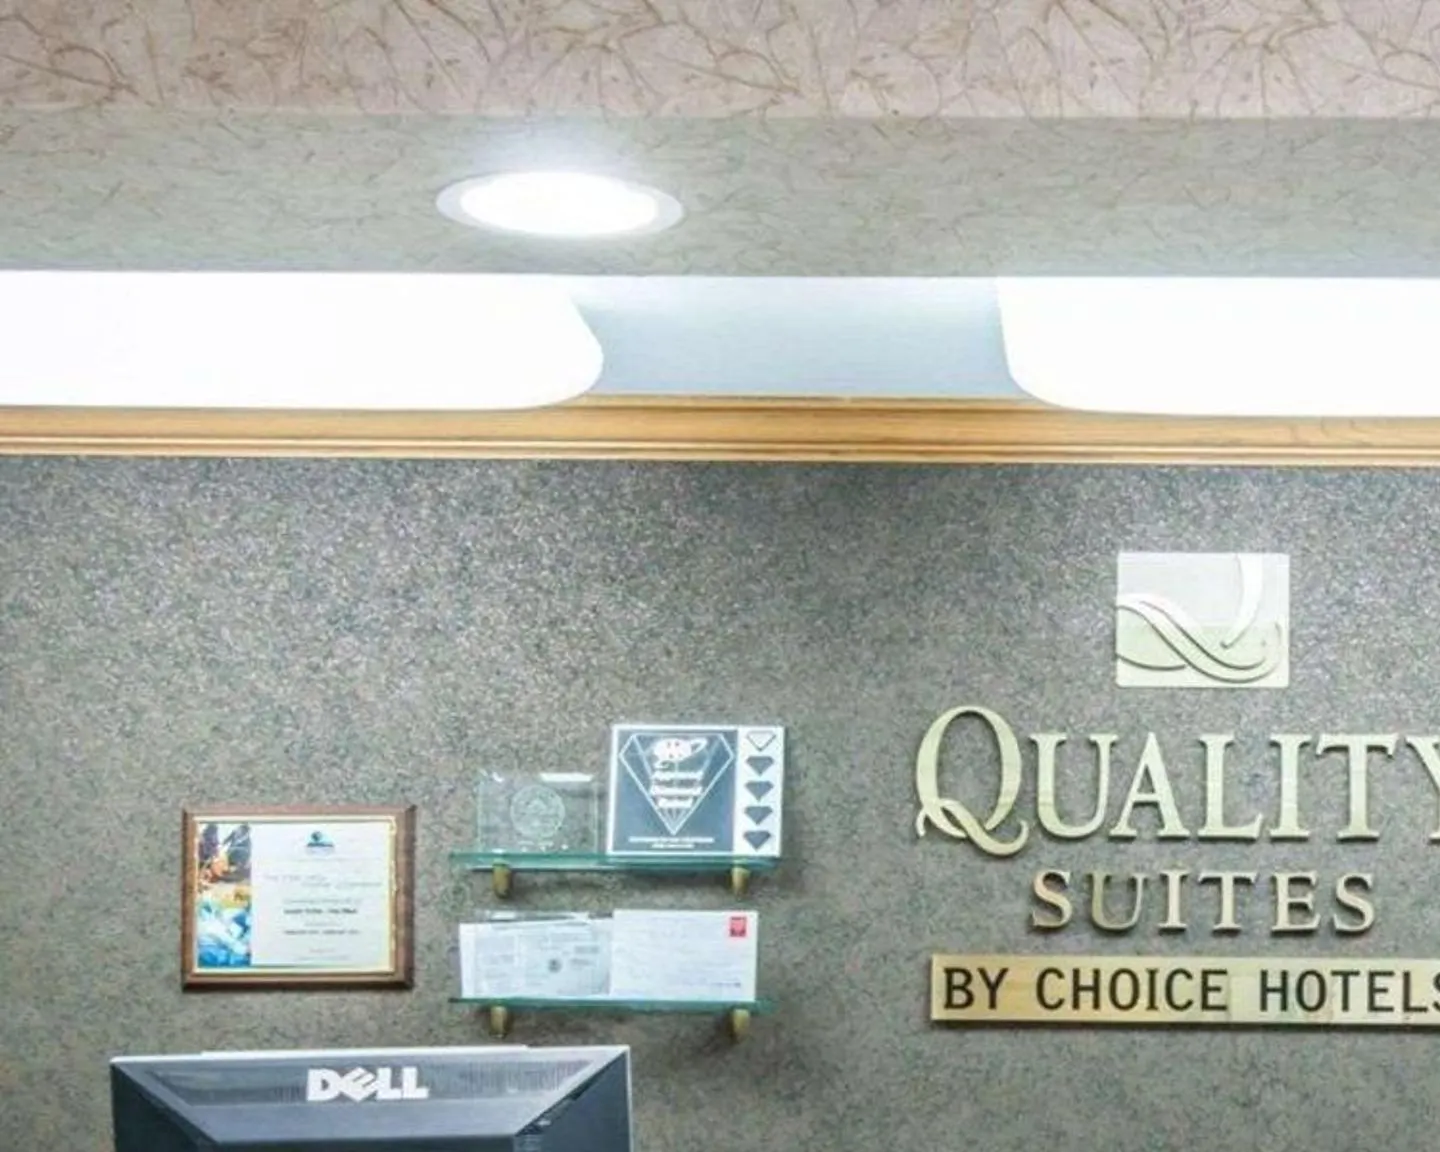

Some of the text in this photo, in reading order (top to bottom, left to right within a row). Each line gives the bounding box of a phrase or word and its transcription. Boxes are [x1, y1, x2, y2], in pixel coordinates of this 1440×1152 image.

[1031, 869, 1376, 934] SUITES
[943, 968, 1009, 1010] BY
[1035, 968, 1228, 1011] CHOICE
[306, 1067, 429, 1102] DELL
